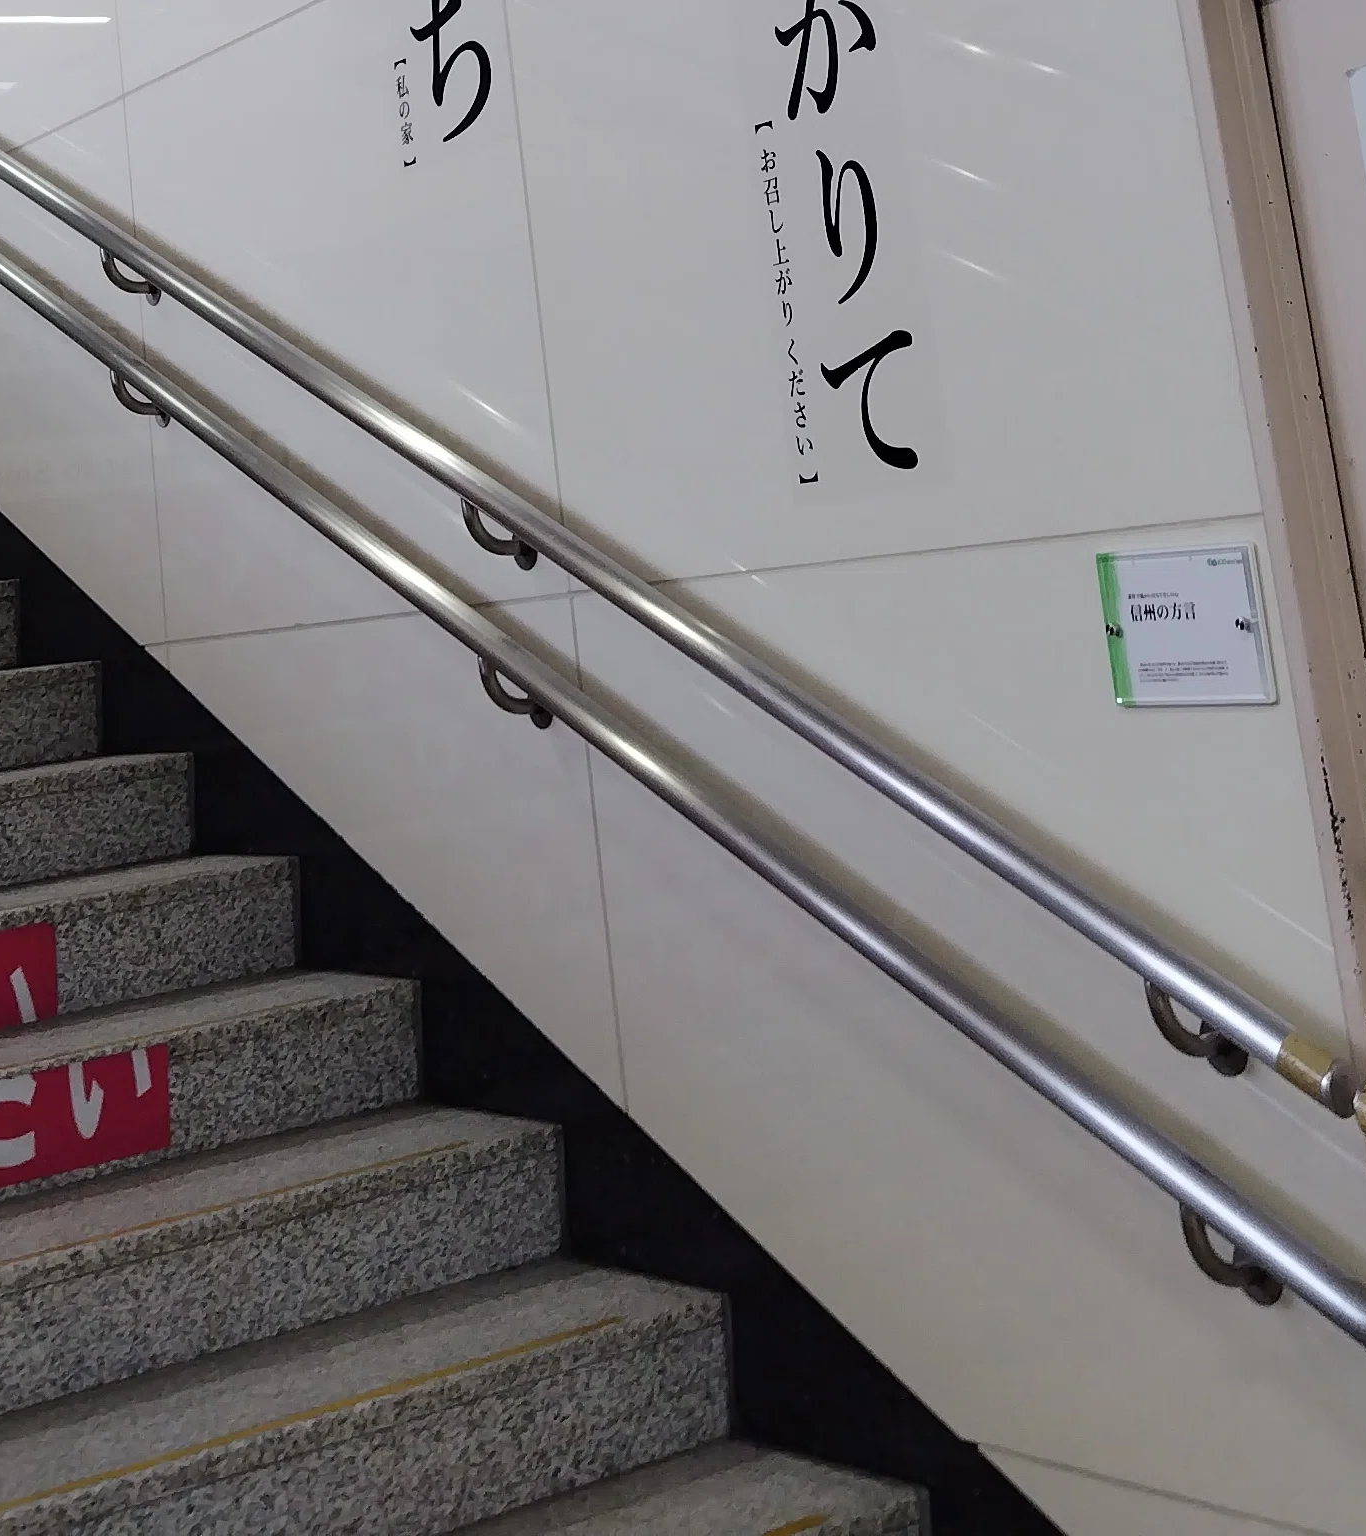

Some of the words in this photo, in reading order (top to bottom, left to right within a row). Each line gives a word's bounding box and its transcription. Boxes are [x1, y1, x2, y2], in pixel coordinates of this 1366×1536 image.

[1130, 601, 1196, 622] 信州の方言
